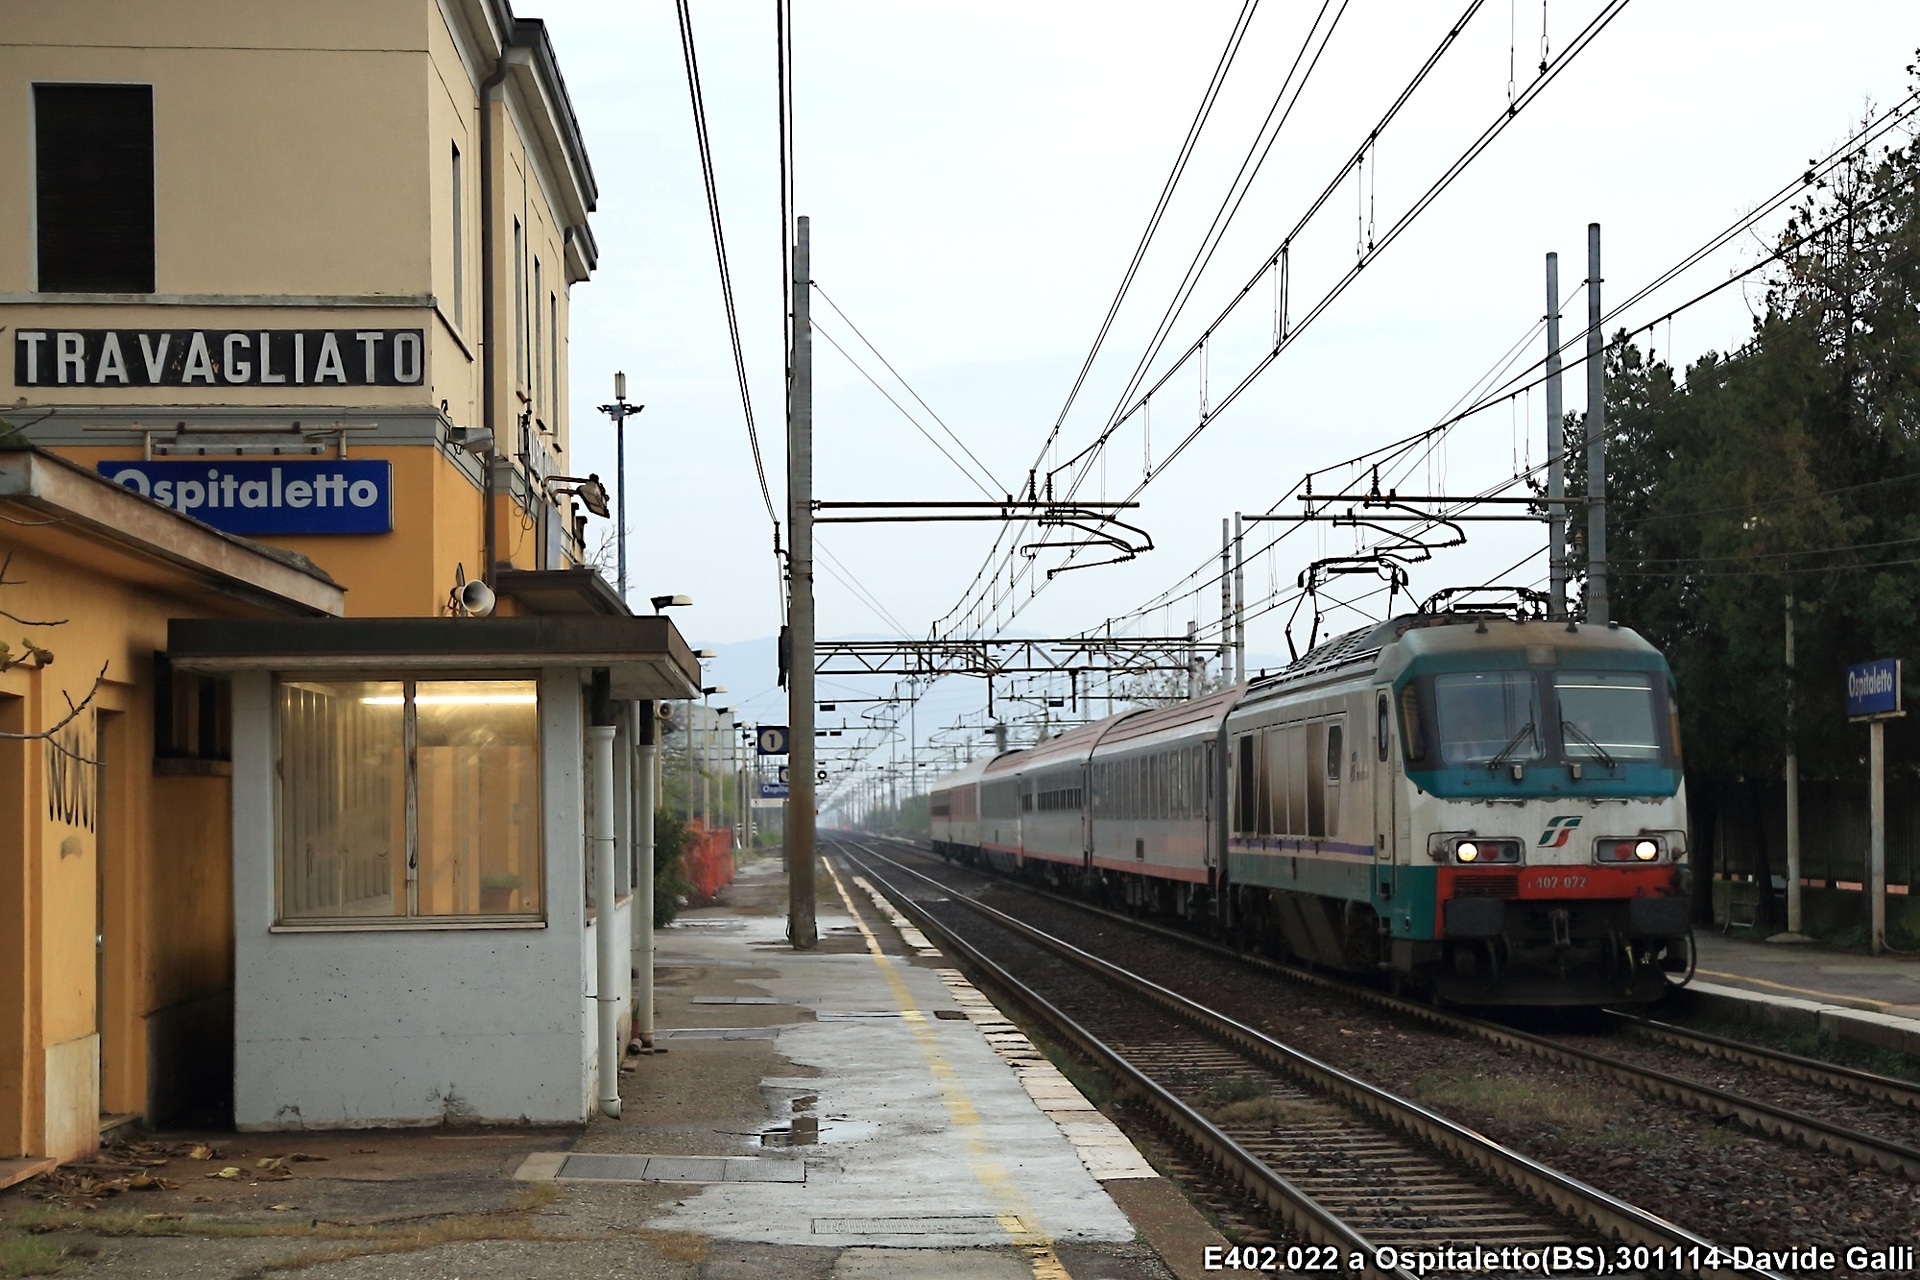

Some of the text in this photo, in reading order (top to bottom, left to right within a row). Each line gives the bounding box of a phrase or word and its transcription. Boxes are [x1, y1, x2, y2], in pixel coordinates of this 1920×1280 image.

[17, 331, 421, 384] TRAVAGLIATO
[1848, 665, 1893, 703] Ospitaletto
[769, 734, 775, 748] 1
